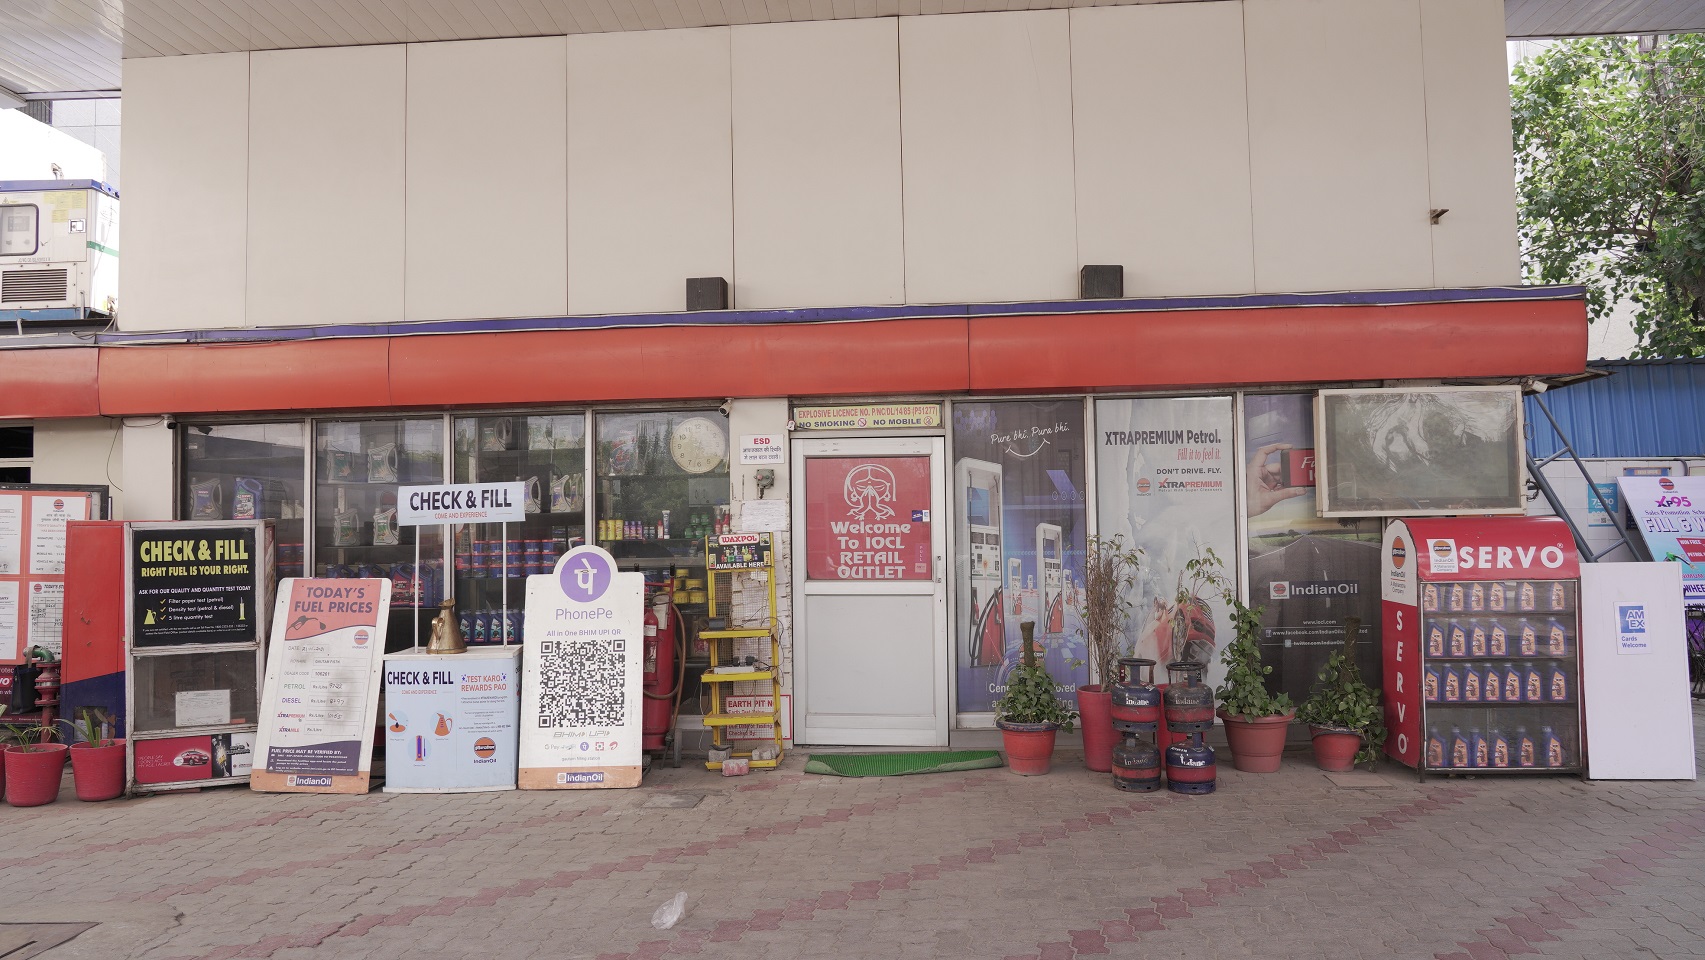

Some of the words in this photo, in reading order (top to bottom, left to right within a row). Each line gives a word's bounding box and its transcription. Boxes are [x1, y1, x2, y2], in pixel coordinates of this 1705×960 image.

[799, 409, 831, 418] EXPLOSIVE
[833, 409, 858, 417] LICENCE
[991, 433, 1012, 445] Pure
[1105, 430, 1184, 446] XTRAPREMIUM
[1187, 429, 1222, 444] Petrol.
[1177, 448, 1188, 460] Fill
[1200, 447, 1214, 463] feel
[1158, 478, 1222, 489] XTRAPREMIUM
[409, 491, 463, 511] CHECK
[466, 490, 478, 509] &
[481, 488, 513, 508] FILL
[830, 521, 911, 534] Welcome
[1641, 516, 1680, 533] FILL
[1677, 516, 1693, 533] &
[721, 535, 758, 543] WAXPOL
[837, 536, 860, 550] To
[865, 536, 905, 550] IOCL
[140, 541, 196, 562] CHECK
[197, 539, 211, 561] &
[215, 539, 249, 561] FILL
[1459, 545, 1564, 569] SERVO
[840, 551, 904, 565] RETAIL
[141, 567, 167, 577] RIGHT
[168, 567, 187, 577] FUEL
[189, 566, 198, 576] IS
[198, 565, 222, 576] YOUR
[223, 564, 249, 575] RIGHT.
[715, 561, 748, 570] AVAILABLE
[748, 560, 765, 568] HERE
[837, 565, 906, 579] OUTLET
[306, 586, 366, 599] TODAY'S
[1291, 583, 1358, 596] IndianOil
[168, 606, 186, 614] Density
[294, 601, 325, 613] FUEL
[328, 602, 374, 613] PRICES
[183, 613, 203, 622] quantity
[555, 607, 617, 621] PhonePe
[611, 628, 622, 636] QR
[388, 671, 421, 685] CHECK
[423, 671, 430, 685] &
[432, 671, 454, 685] FILL
[483, 674, 502, 683] KARO
[1396, 610, 1408, 754] SERVO
[461, 683, 492, 692] REWARDS
[494, 683, 507, 691] PAO
[553, 730, 582, 738] BHIM
[297, 777, 331, 786] IndianOil
[567, 773, 604, 782] IndianOil
